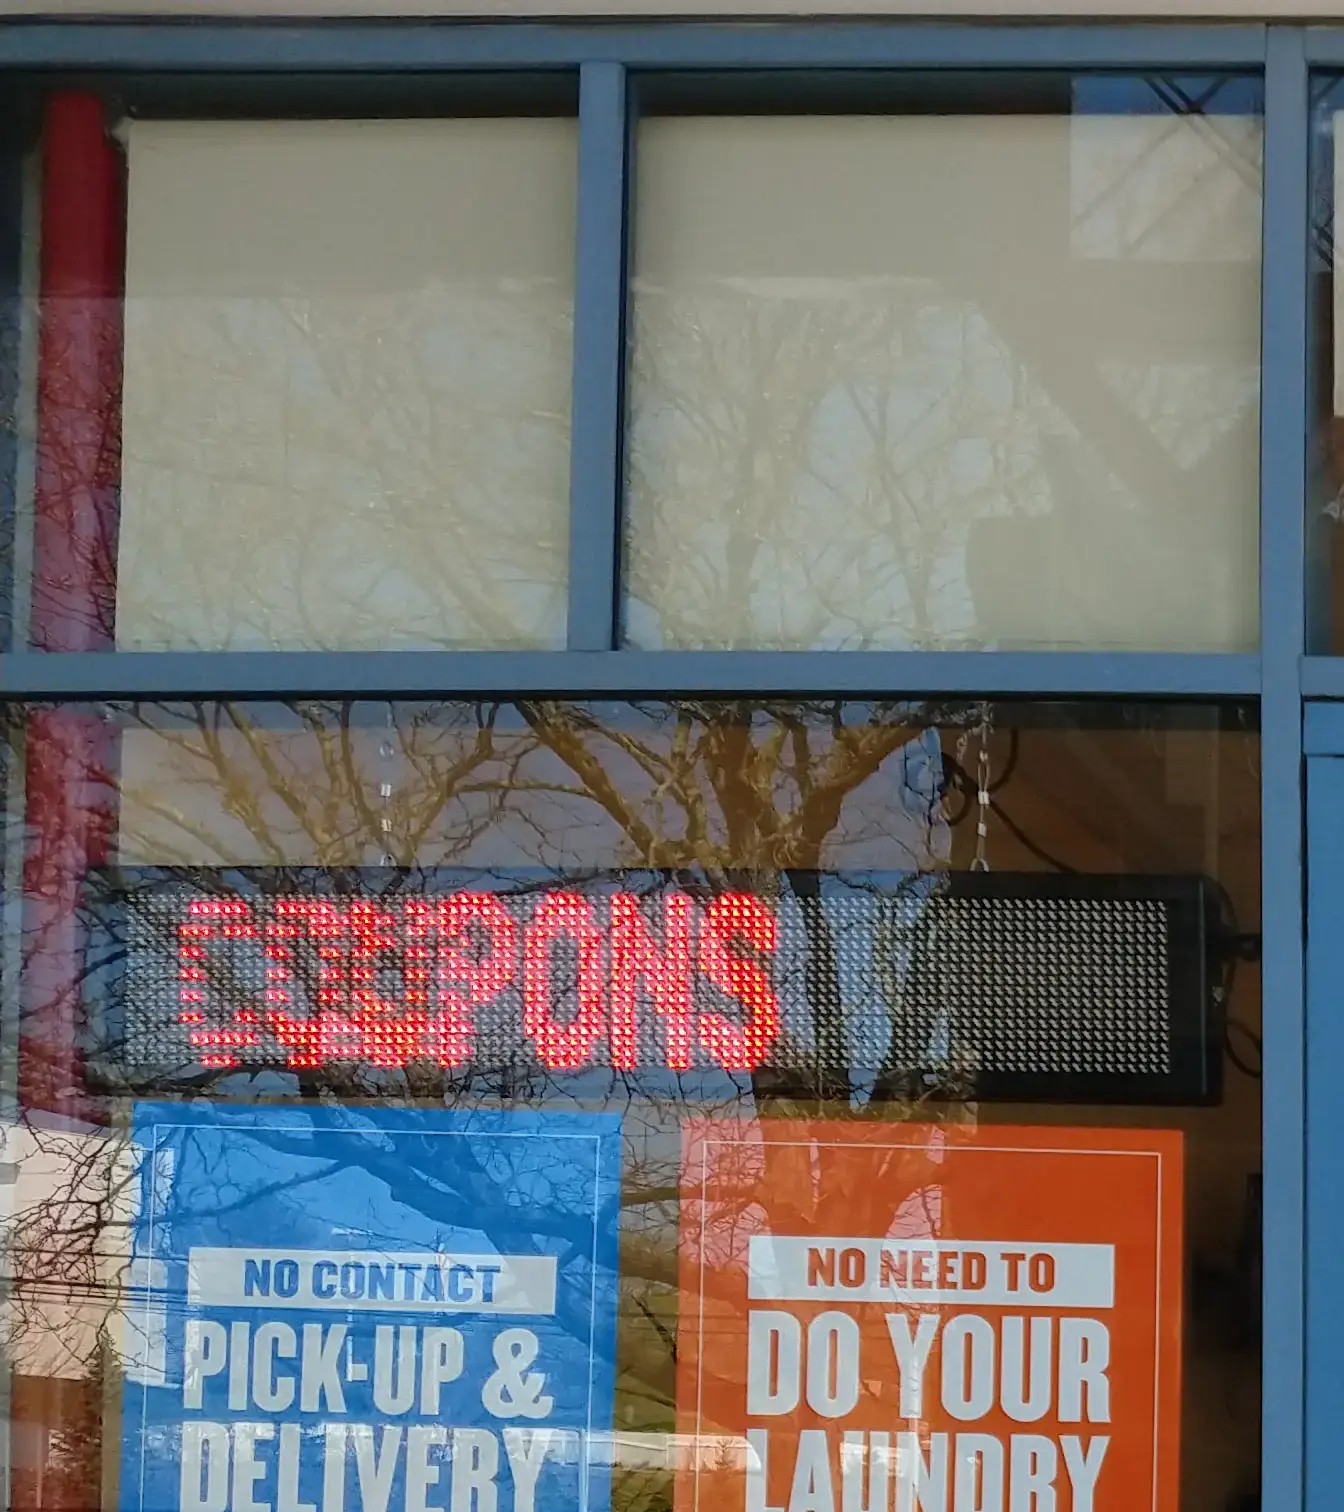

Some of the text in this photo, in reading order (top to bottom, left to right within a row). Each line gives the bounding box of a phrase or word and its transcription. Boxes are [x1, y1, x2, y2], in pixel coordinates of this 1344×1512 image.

[244, 1259, 501, 1304] NO CONTACT
[807, 1246, 1056, 1295] NO NEED TO
[183, 1320, 555, 1420] PICK-UP &
[746, 1309, 1112, 1425] DO YOUR
